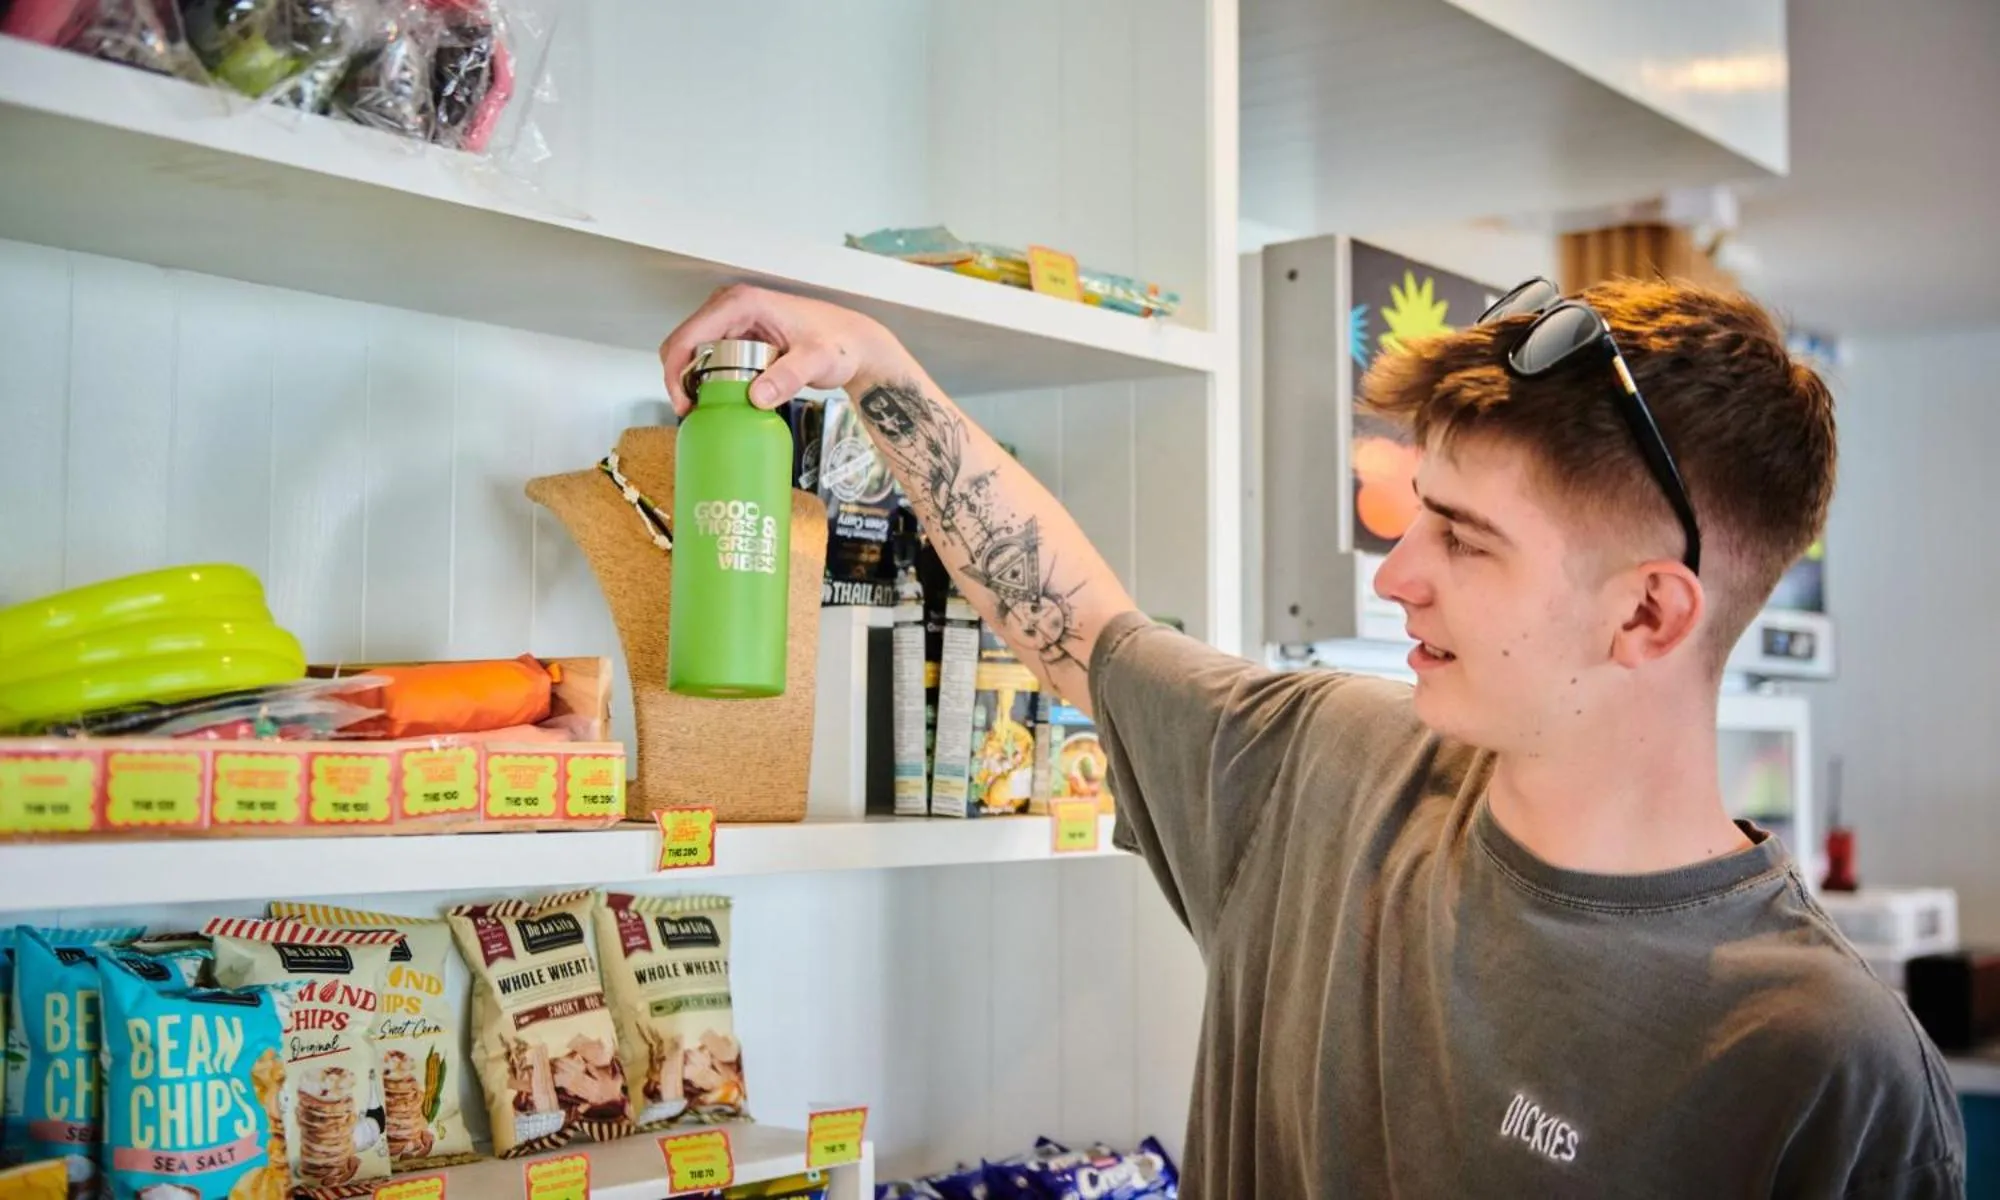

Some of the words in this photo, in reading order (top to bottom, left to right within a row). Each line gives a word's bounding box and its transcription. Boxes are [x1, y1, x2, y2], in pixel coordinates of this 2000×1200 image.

[694, 500, 760, 521] GOOD
[697, 519, 758, 537] TIMES
[762, 515, 777, 538] &
[718, 552, 777, 574] VIBES
[833, 581, 894, 605] THAILAN
[498, 970, 546, 995] WHOLE
[547, 957, 588, 981] WHEAT
[634, 962, 681, 985] WHOLE
[682, 960, 721, 977] WHEAT
[45, 989, 99, 1053] BE
[547, 1000, 579, 1018] SMOKY
[378, 1019, 412, 1040] Sweet
[412, 1018, 443, 1038] Corn
[127, 1014, 243, 1080] BEAN
[290, 1034, 341, 1060] Original
[129, 1078, 256, 1150] CHIPS
[1500, 1094, 1579, 1161] DICKIES
[153, 1154, 190, 1173] SEA
[195, 1148, 237, 1171] SALT
